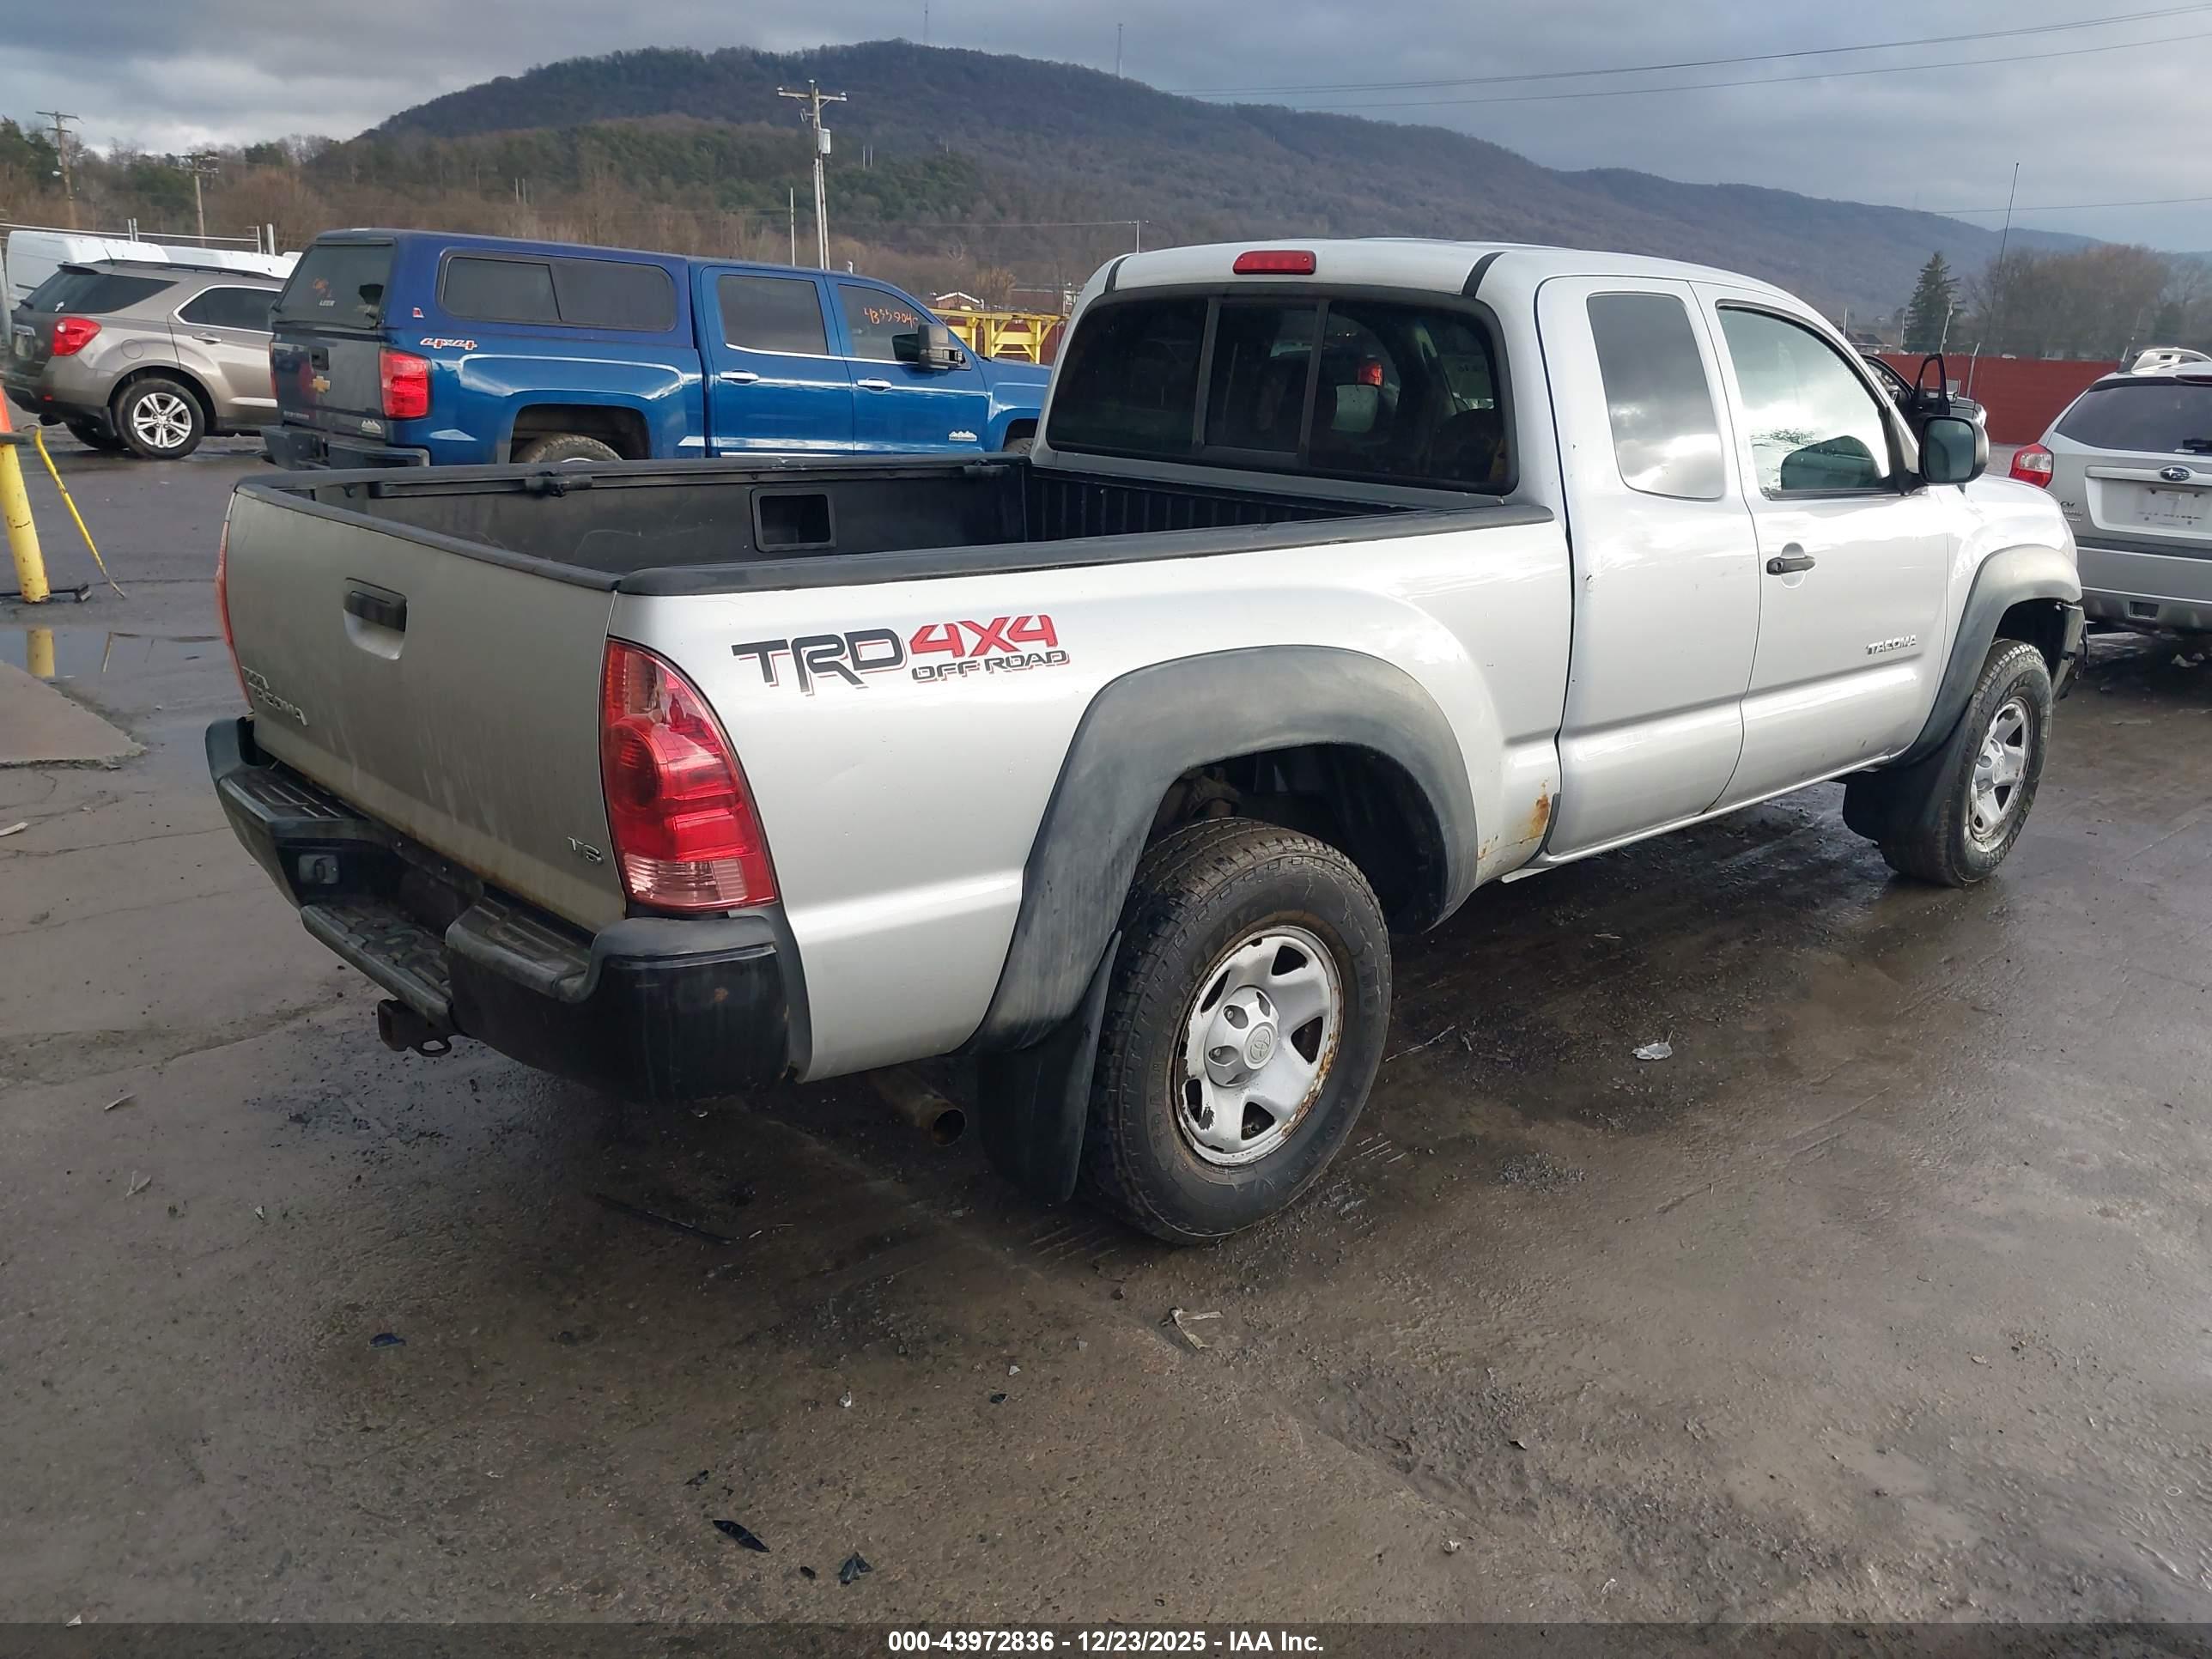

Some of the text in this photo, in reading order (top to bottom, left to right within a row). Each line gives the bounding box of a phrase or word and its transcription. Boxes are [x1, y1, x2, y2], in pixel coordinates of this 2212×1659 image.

[1866, 635, 1917, 656] TACOMA
[732, 628, 906, 697] TRD
[911, 648, 1071, 684] OFF ROAD
[567, 836, 603, 865] V6
